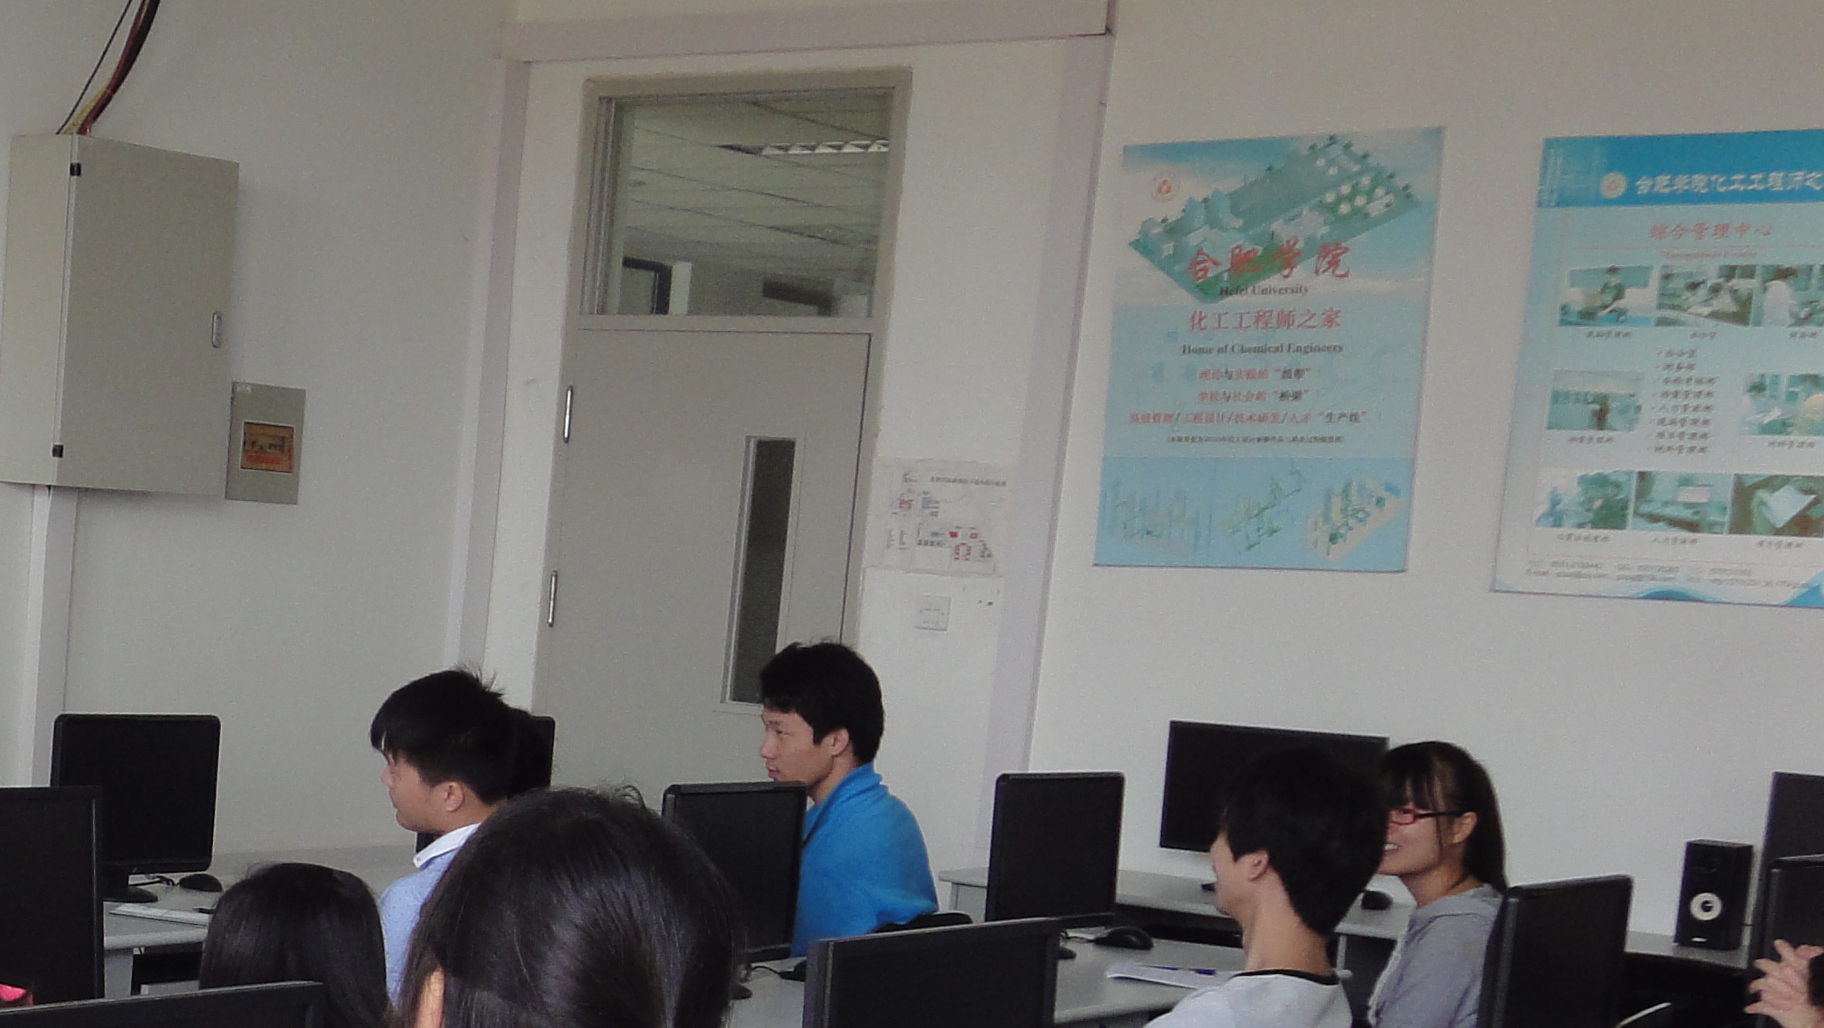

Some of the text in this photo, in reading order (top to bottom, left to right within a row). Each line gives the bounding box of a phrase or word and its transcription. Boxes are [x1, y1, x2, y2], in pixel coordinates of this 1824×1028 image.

[1185, 236, 1351, 283] 合肥学院
[1252, 283, 1309, 297] University
[1187, 307, 1341, 331] 化工工程师之家
[1182, 343, 1344, 355] Home of Chemical Engineers
